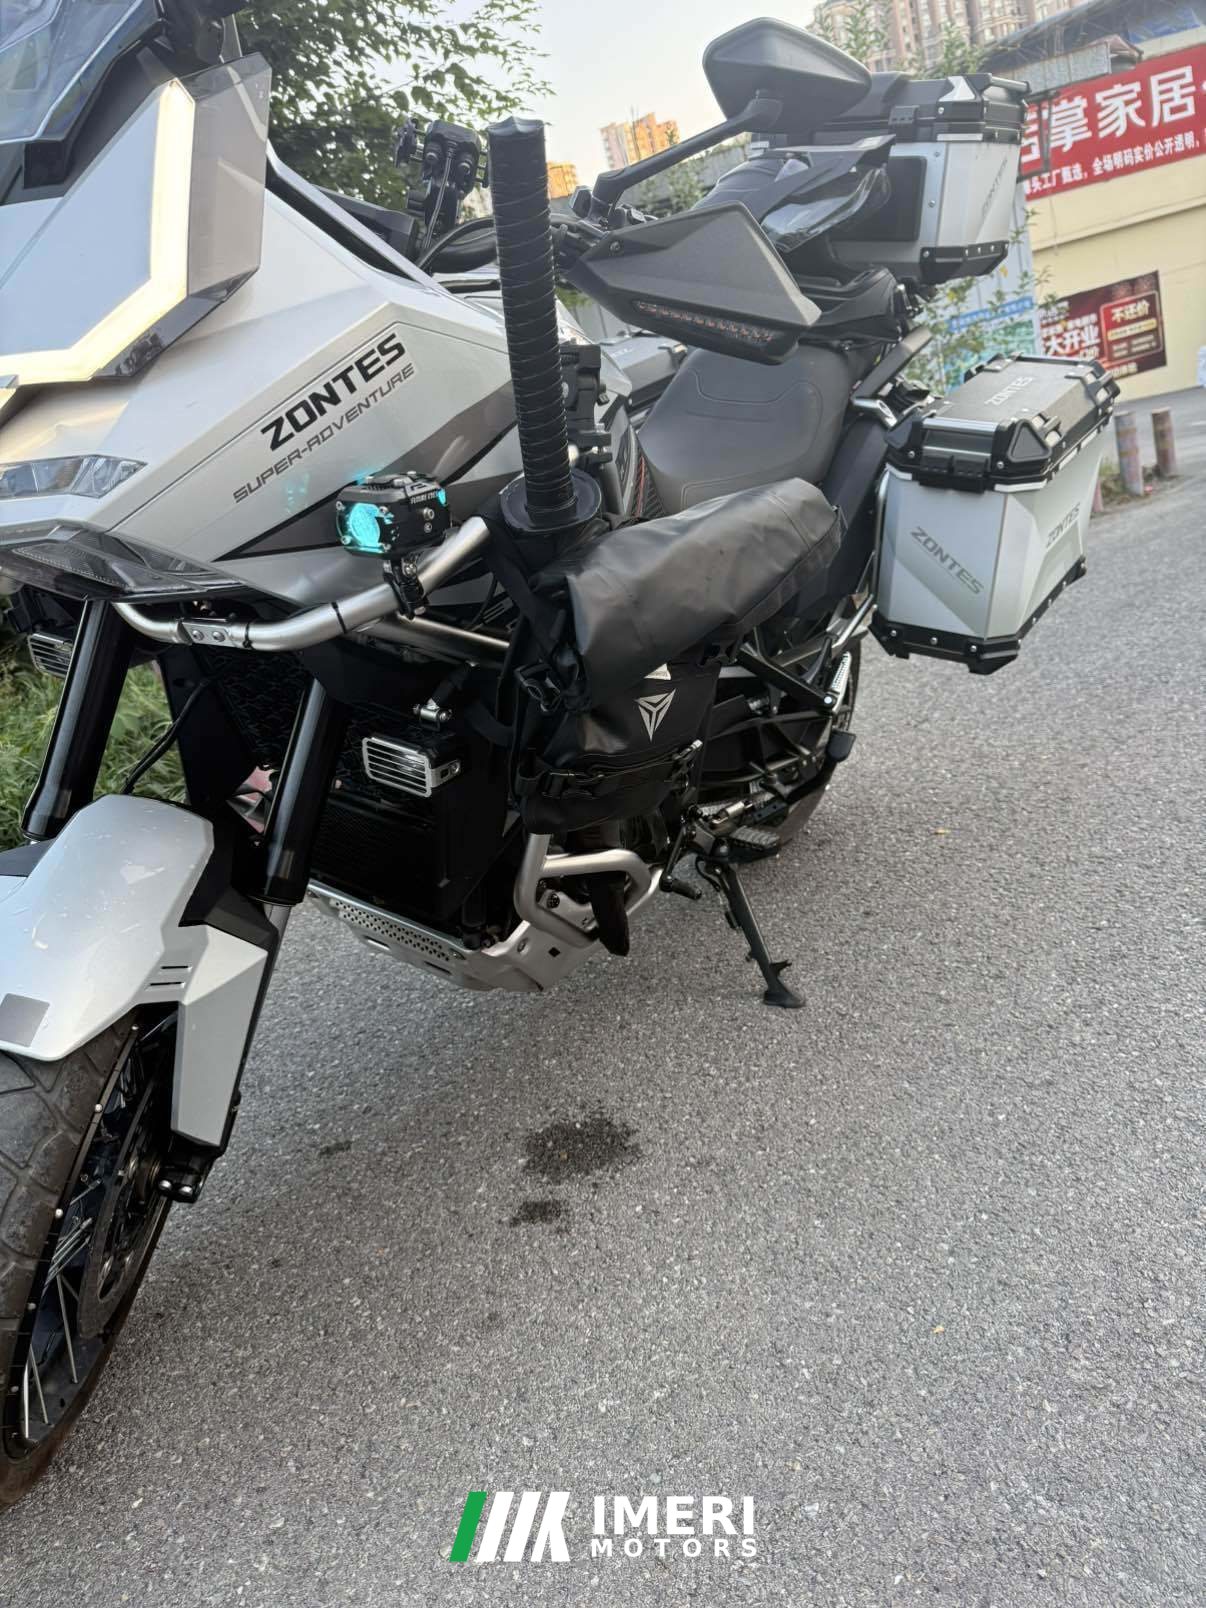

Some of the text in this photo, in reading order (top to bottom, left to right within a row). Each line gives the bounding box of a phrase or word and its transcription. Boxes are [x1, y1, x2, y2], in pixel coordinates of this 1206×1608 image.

[1040, 325, 1101, 356] 大开业
[232, 363, 415, 504] SUPER-ADVENTURE
[260, 333, 406, 452] ZONTES
[910, 526, 985, 595] ZONTES
